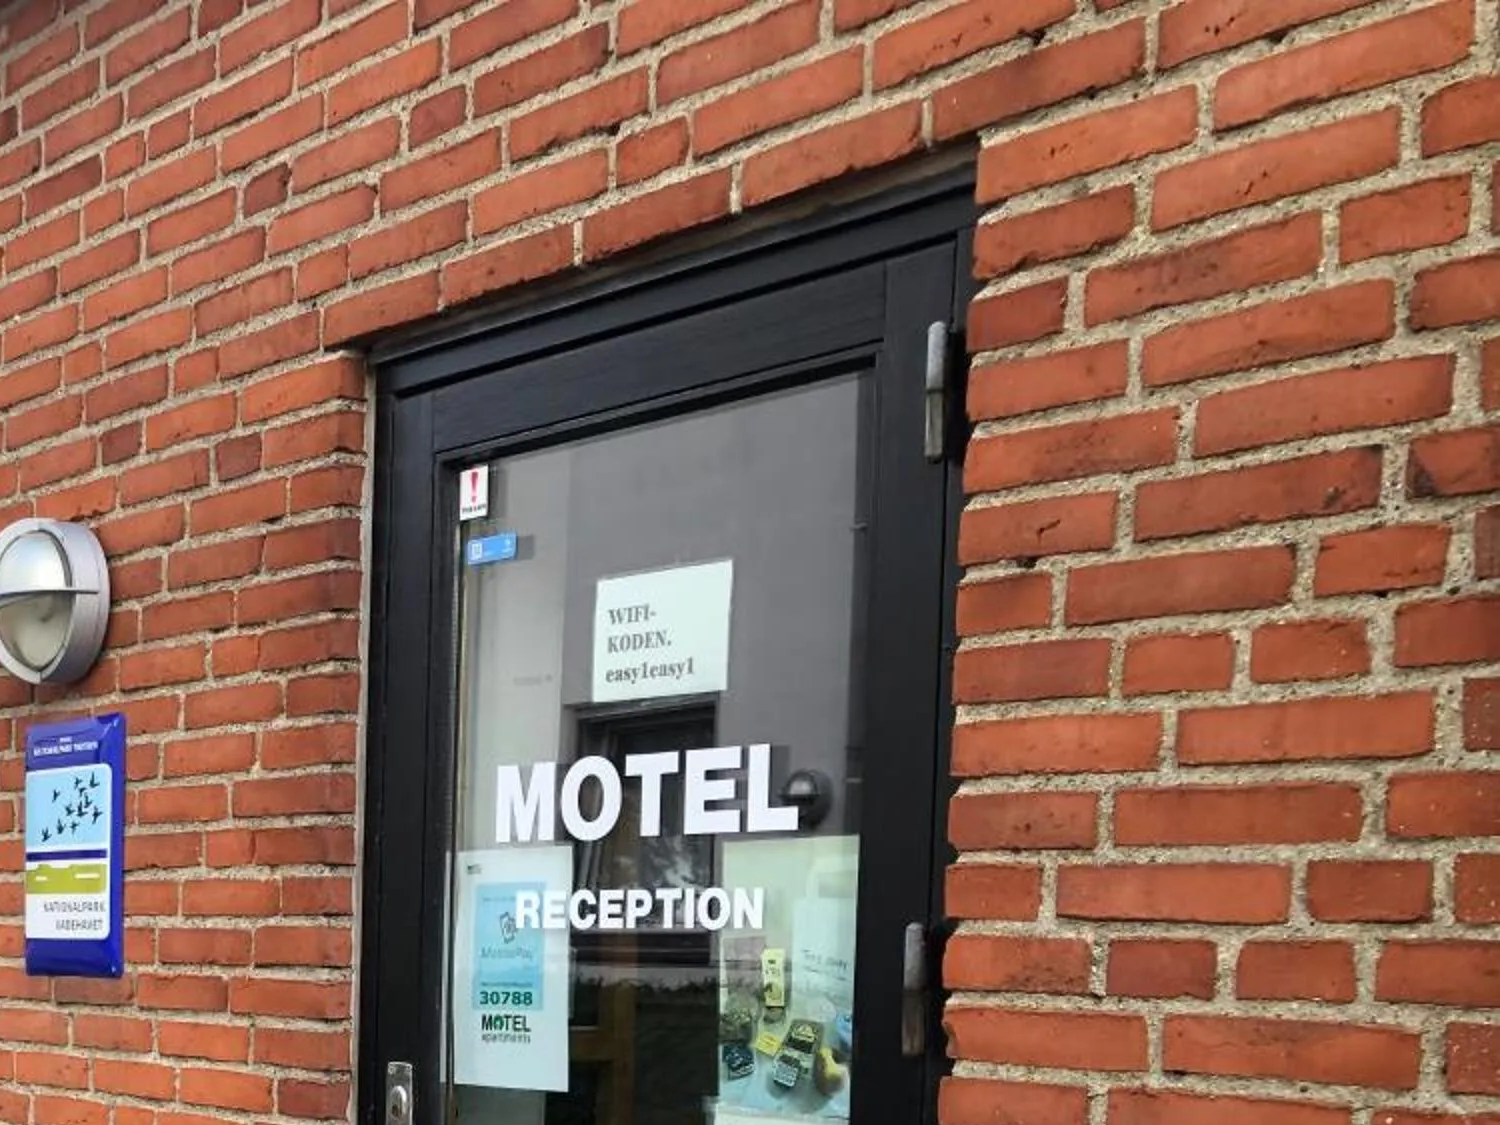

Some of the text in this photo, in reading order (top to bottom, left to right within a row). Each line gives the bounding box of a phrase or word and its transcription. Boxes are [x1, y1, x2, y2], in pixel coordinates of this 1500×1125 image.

[607, 604, 657, 625] WIFI-
[607, 630, 672, 654] KODEN.
[495, 743, 799, 843] MOTEL
[515, 887, 765, 931] RECEPTION
[479, 990, 533, 1006] 30788
[481, 1013, 531, 1032] MOTEL
